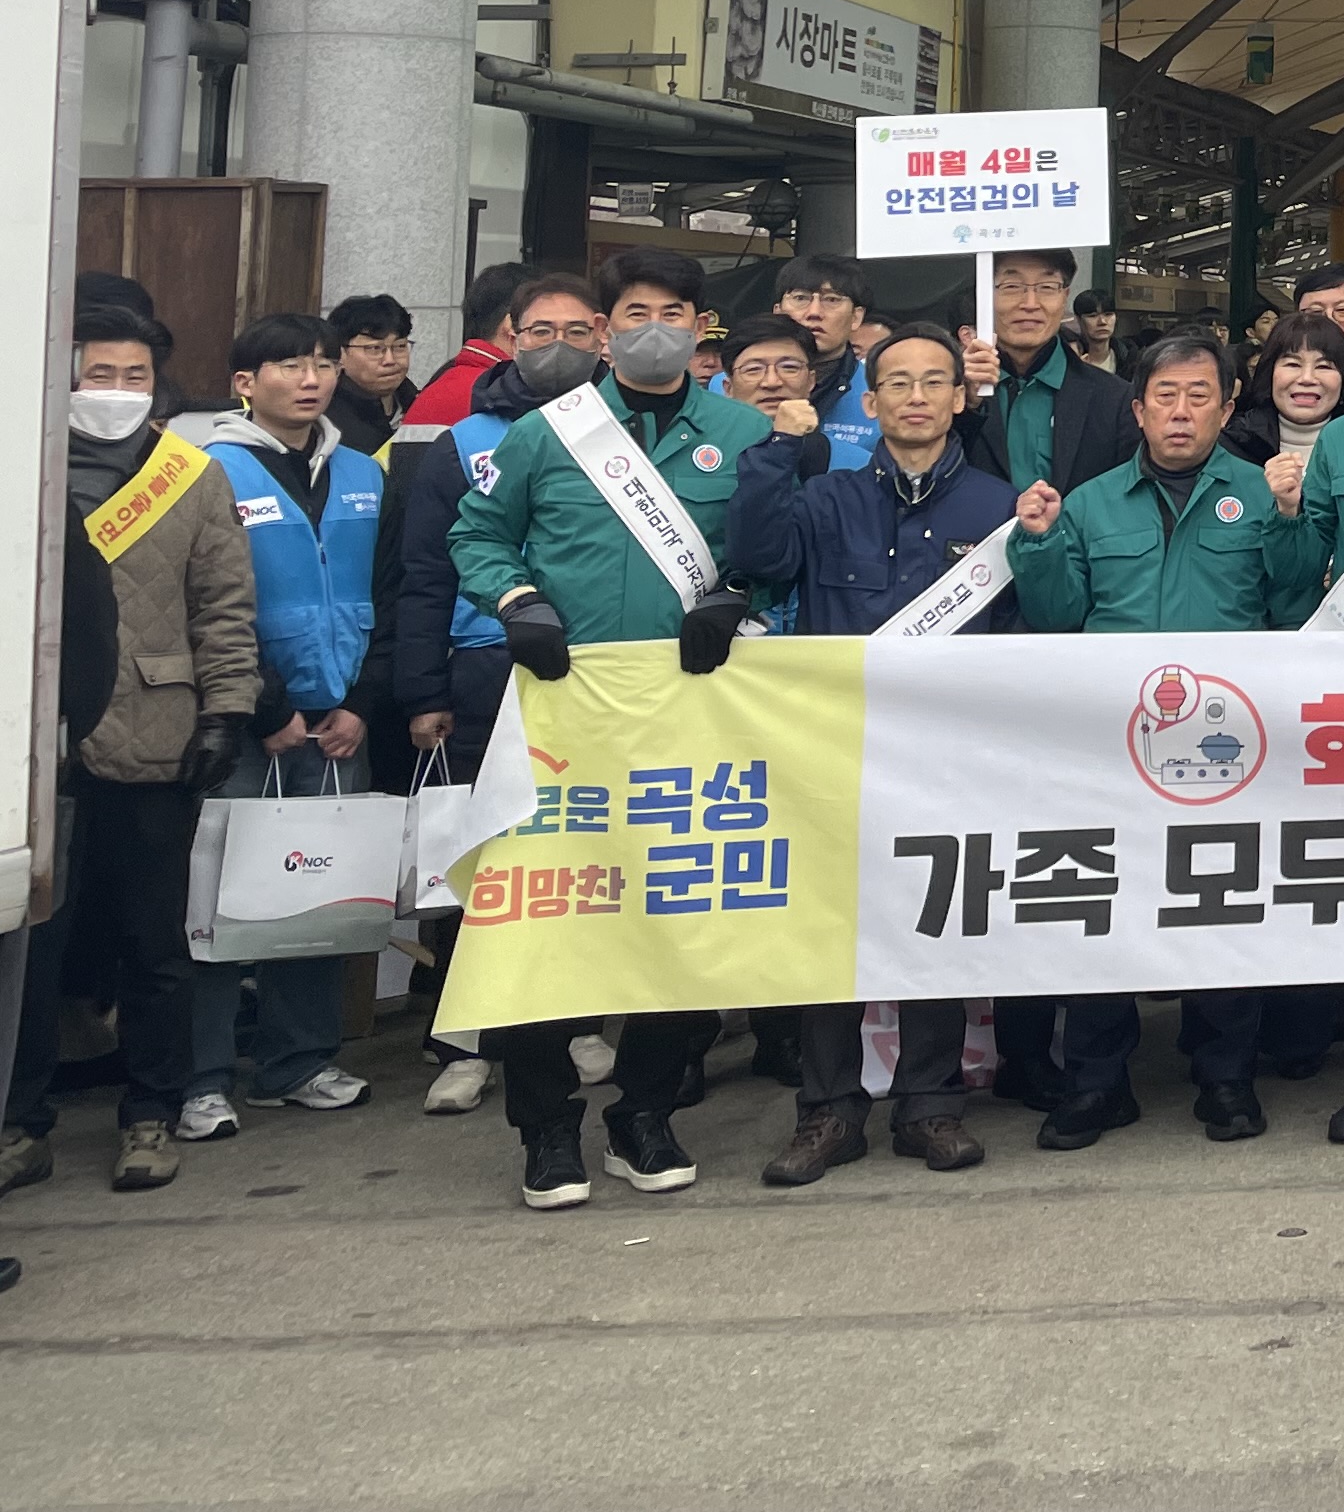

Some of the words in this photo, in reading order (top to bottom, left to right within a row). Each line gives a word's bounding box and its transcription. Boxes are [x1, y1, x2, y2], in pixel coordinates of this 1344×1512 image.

[775, 6, 857, 74] 시장마트
[886, 183, 1039, 215] 안전점검의
[1052, 181, 1080, 208] 날
[907, 150, 967, 177] 매월
[980, 147, 1059, 174] 4일은
[622, 476, 684, 548] 대한민국
[496, 785, 610, 838] 로운
[627, 759, 770, 835] 곡성
[462, 863, 626, 927] 희망찬
[645, 837, 790, 916] 군민
[893, 826, 1119, 939] 가족
